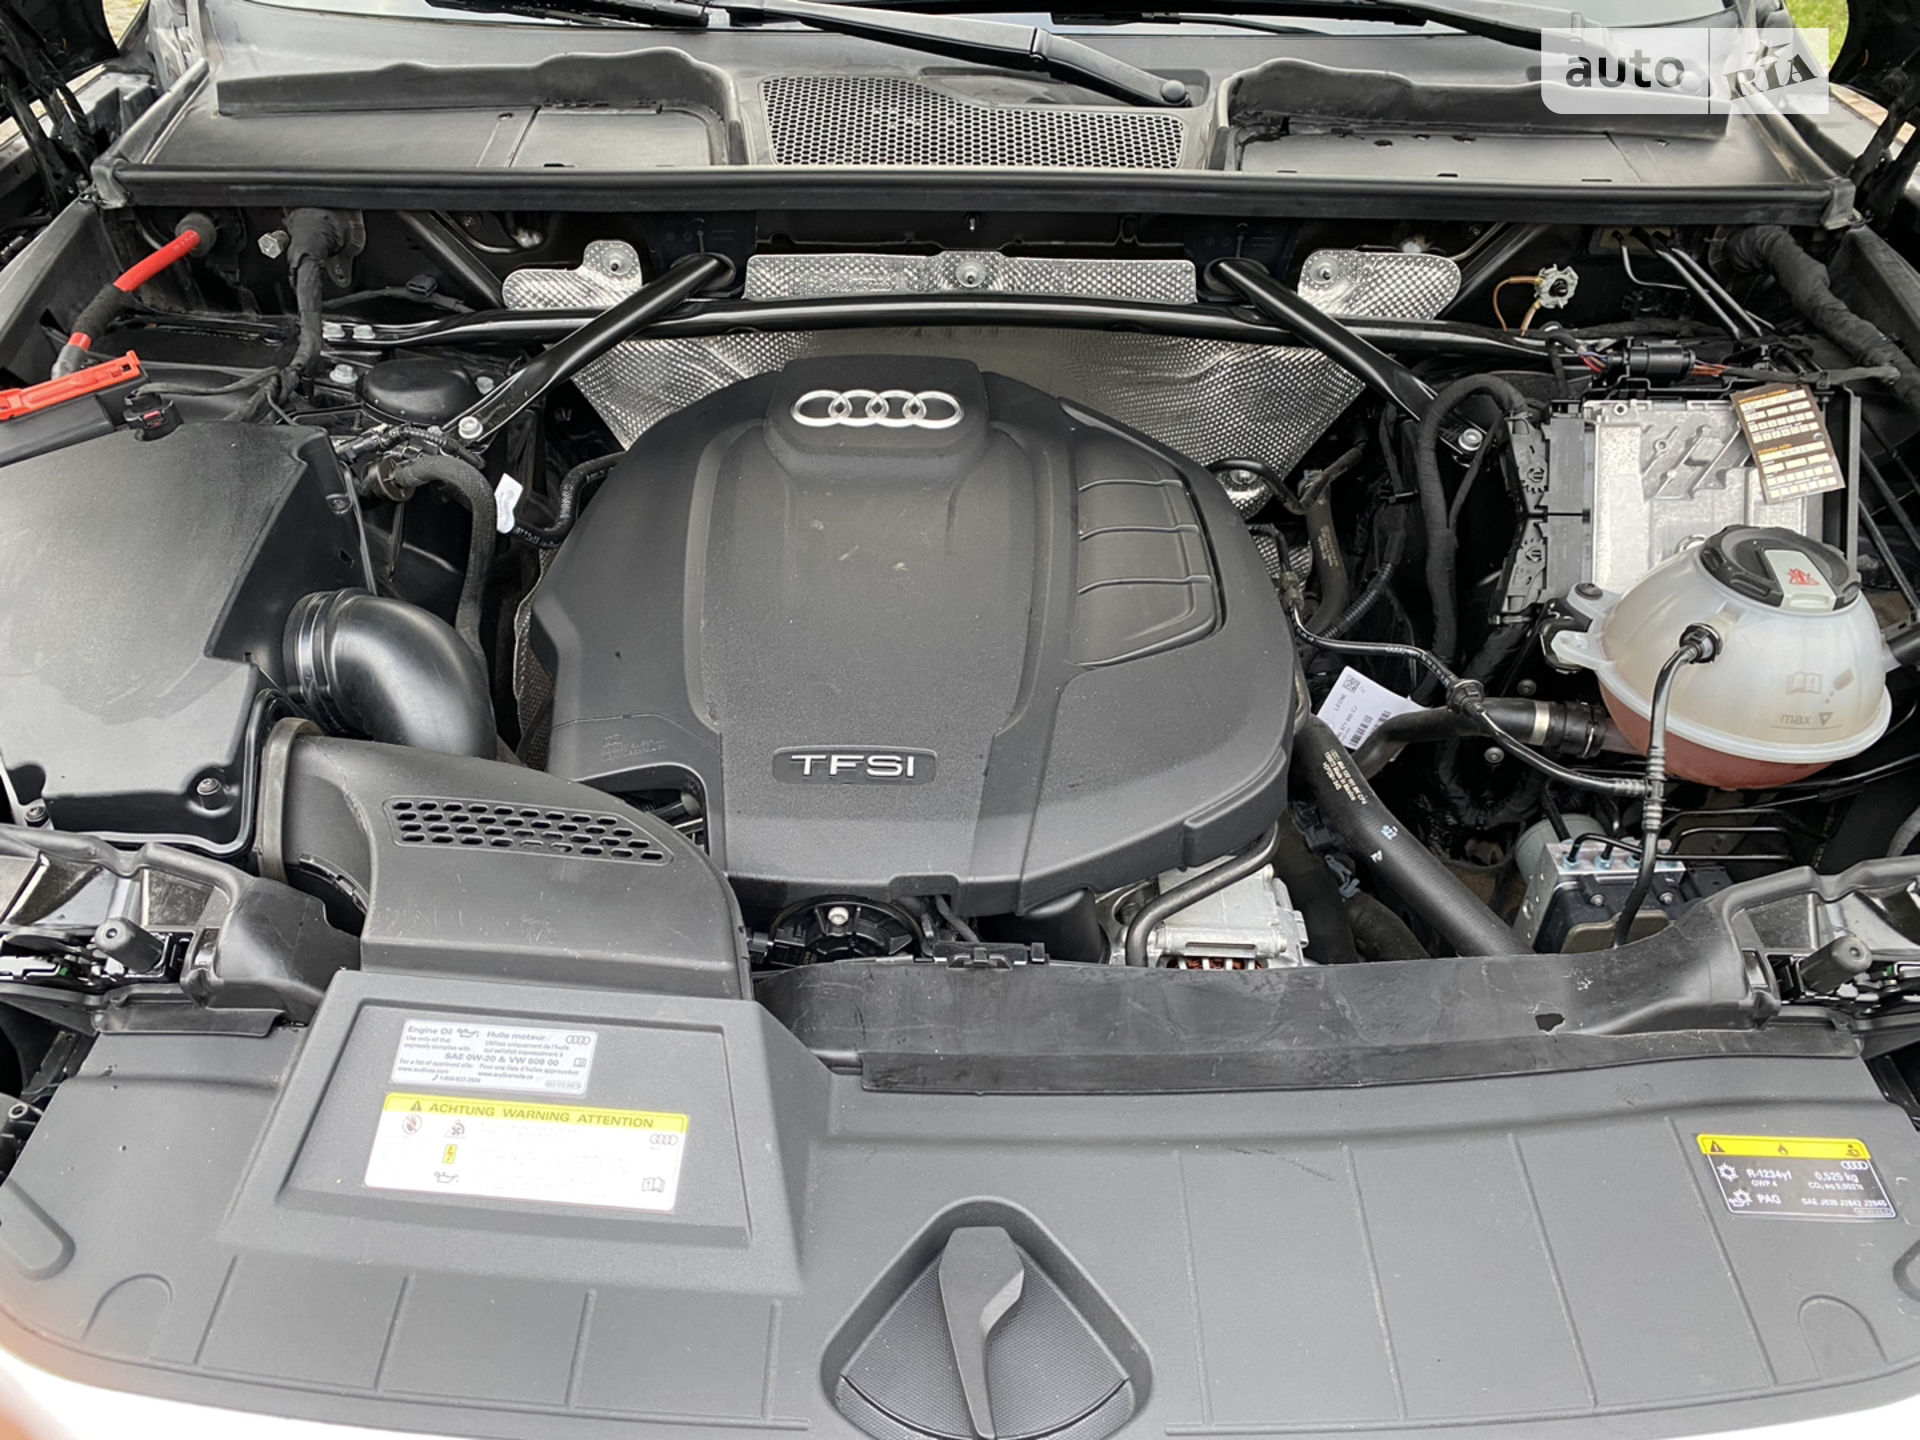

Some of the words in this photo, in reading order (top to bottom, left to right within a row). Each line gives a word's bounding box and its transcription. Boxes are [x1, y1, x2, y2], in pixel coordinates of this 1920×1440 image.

[1333, 694, 1346, 711] LEONI
[1780, 714, 1812, 725] max
[791, 755, 914, 777] TFSI
[408, 1026, 438, 1035] Engine
[440, 1027, 453, 1035] Oil
[487, 1030, 509, 1039] Huile
[512, 1033, 545, 1041] moteur
[445, 1052, 464, 1060] SAE
[466, 1054, 496, 1062] 0W-20
[498, 1055, 506, 1063] &
[509, 1056, 526, 1064] VW
[432, 1060, 460, 1068] approved
[477, 1071, 534, 1080] www.audicanada.ca
[429, 1103, 495, 1117] ACHTUNG
[503, 1108, 570, 1123] WARNING
[577, 1113, 654, 1129] ATTENTION
[1746, 1168, 1792, 1181] R-1234yf
[1814, 1171, 1843, 1182] 0,525
[1845, 1172, 1859, 1183] kg
[1825, 1183, 1836, 1191] eq
[1757, 1194, 1782, 1204] PAG
[1801, 1198, 1818, 1206] SAE
